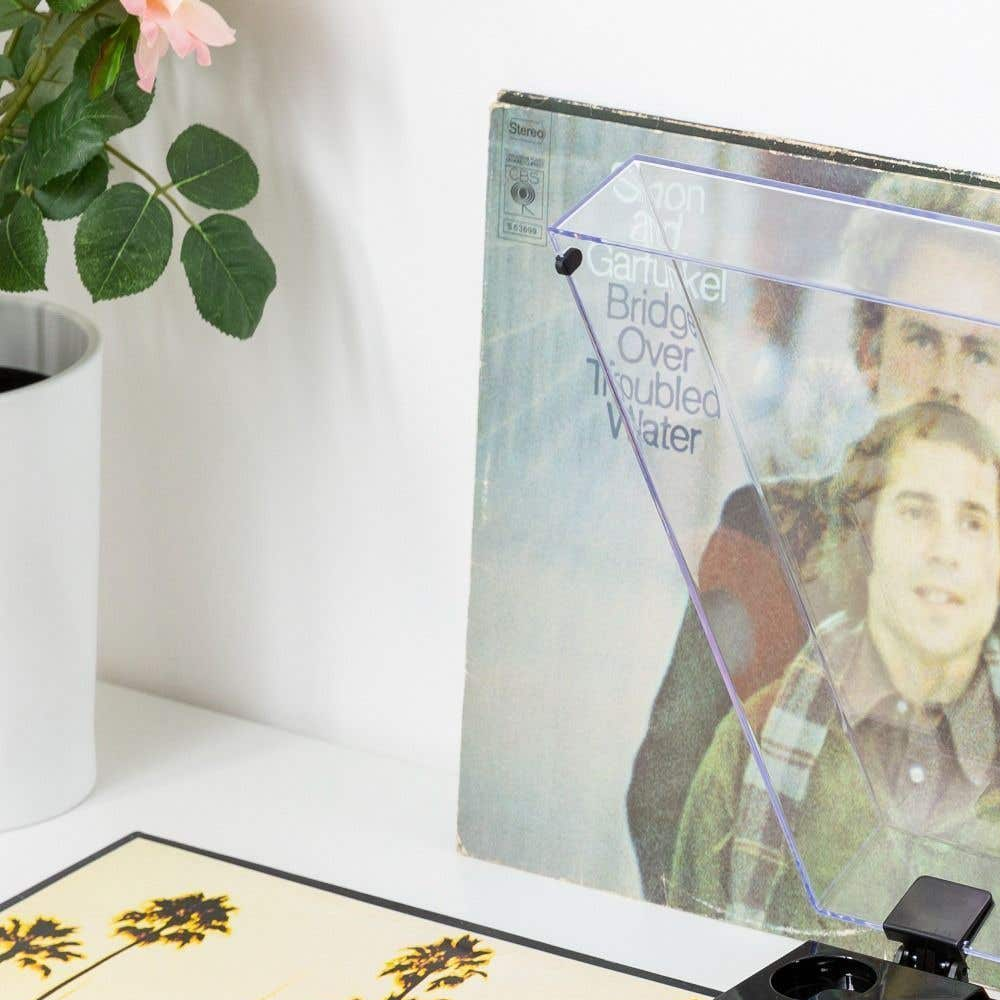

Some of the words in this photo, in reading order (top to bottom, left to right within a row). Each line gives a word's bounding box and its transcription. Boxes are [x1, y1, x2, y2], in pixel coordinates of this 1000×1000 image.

[508, 122, 546, 139] Stereo
[607, 282, 697, 340] Bridge
[618, 326, 694, 373] Over
[586, 356, 721, 420] Troubled
[606, 401, 702, 455] Water
